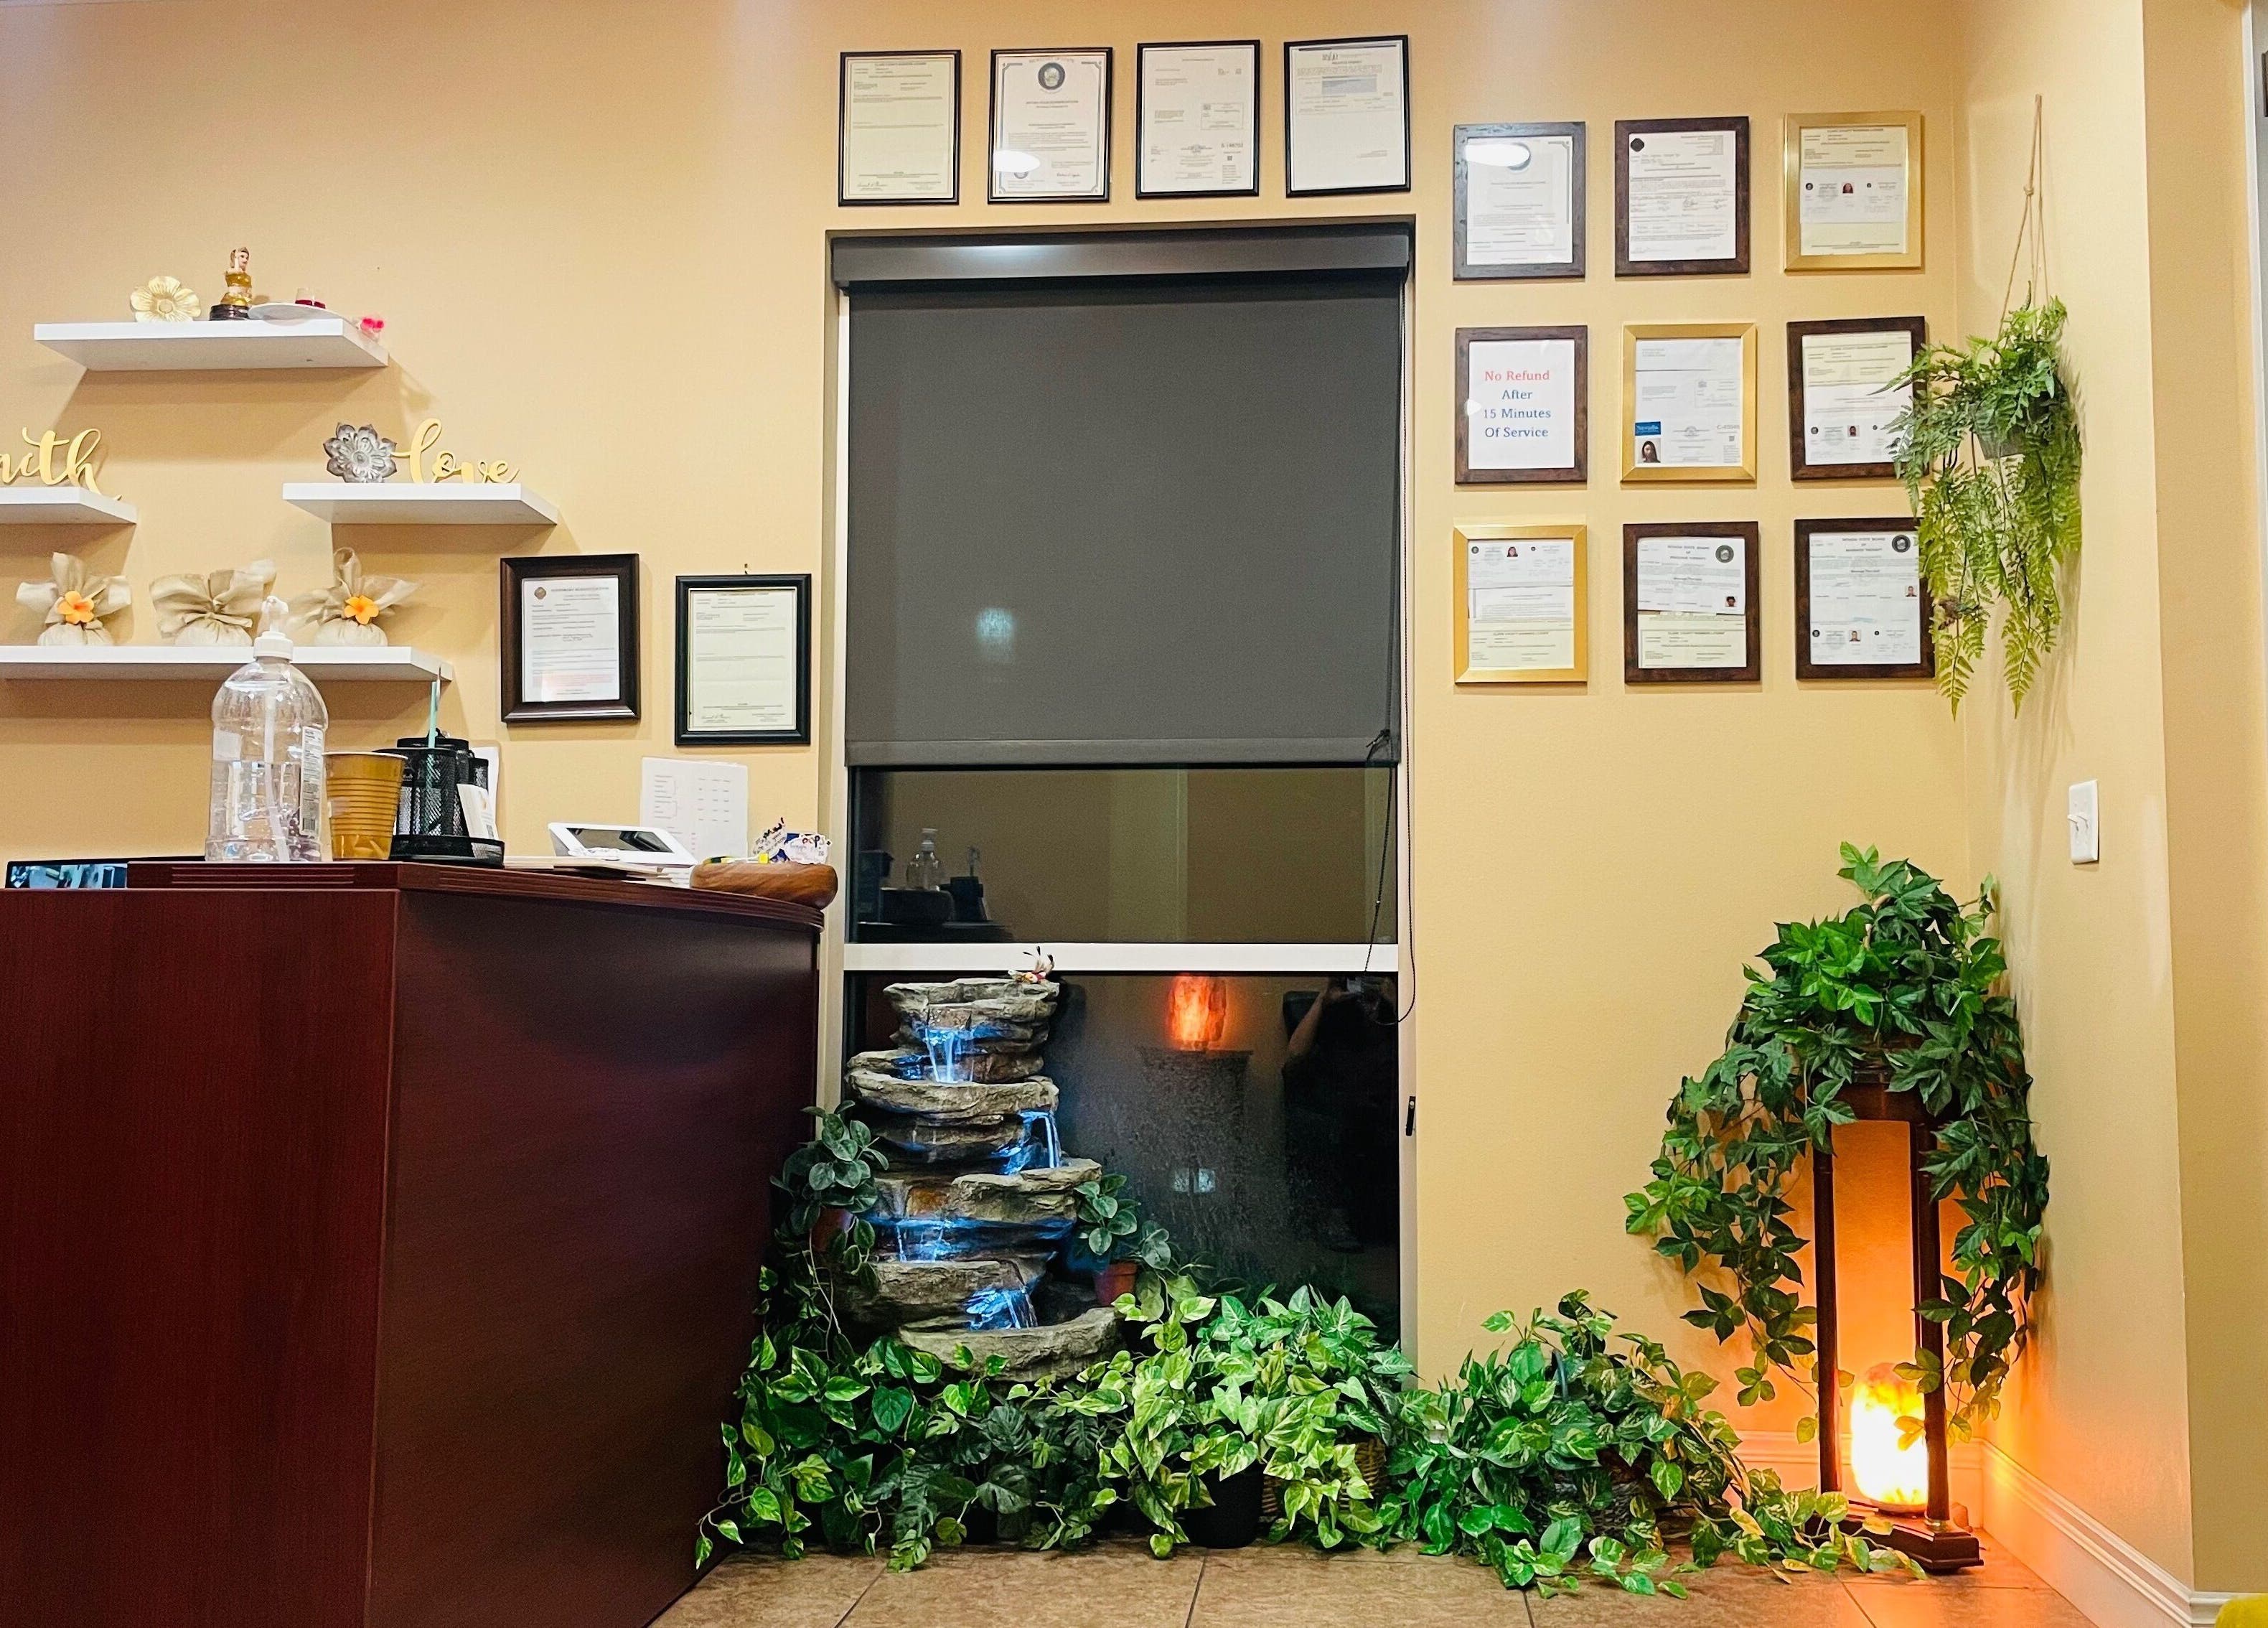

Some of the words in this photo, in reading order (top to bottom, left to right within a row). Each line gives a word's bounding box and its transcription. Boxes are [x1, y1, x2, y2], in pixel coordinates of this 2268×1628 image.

[1484, 371, 1501, 381] No
[1506, 370, 1550, 380] Refund
[1501, 389, 1532, 400] After
[1484, 408, 1496, 418] 15
[1501, 408, 1551, 418] Minutes
[1485, 426, 1501, 437] Of
[1503, 426, 1549, 437] Service
